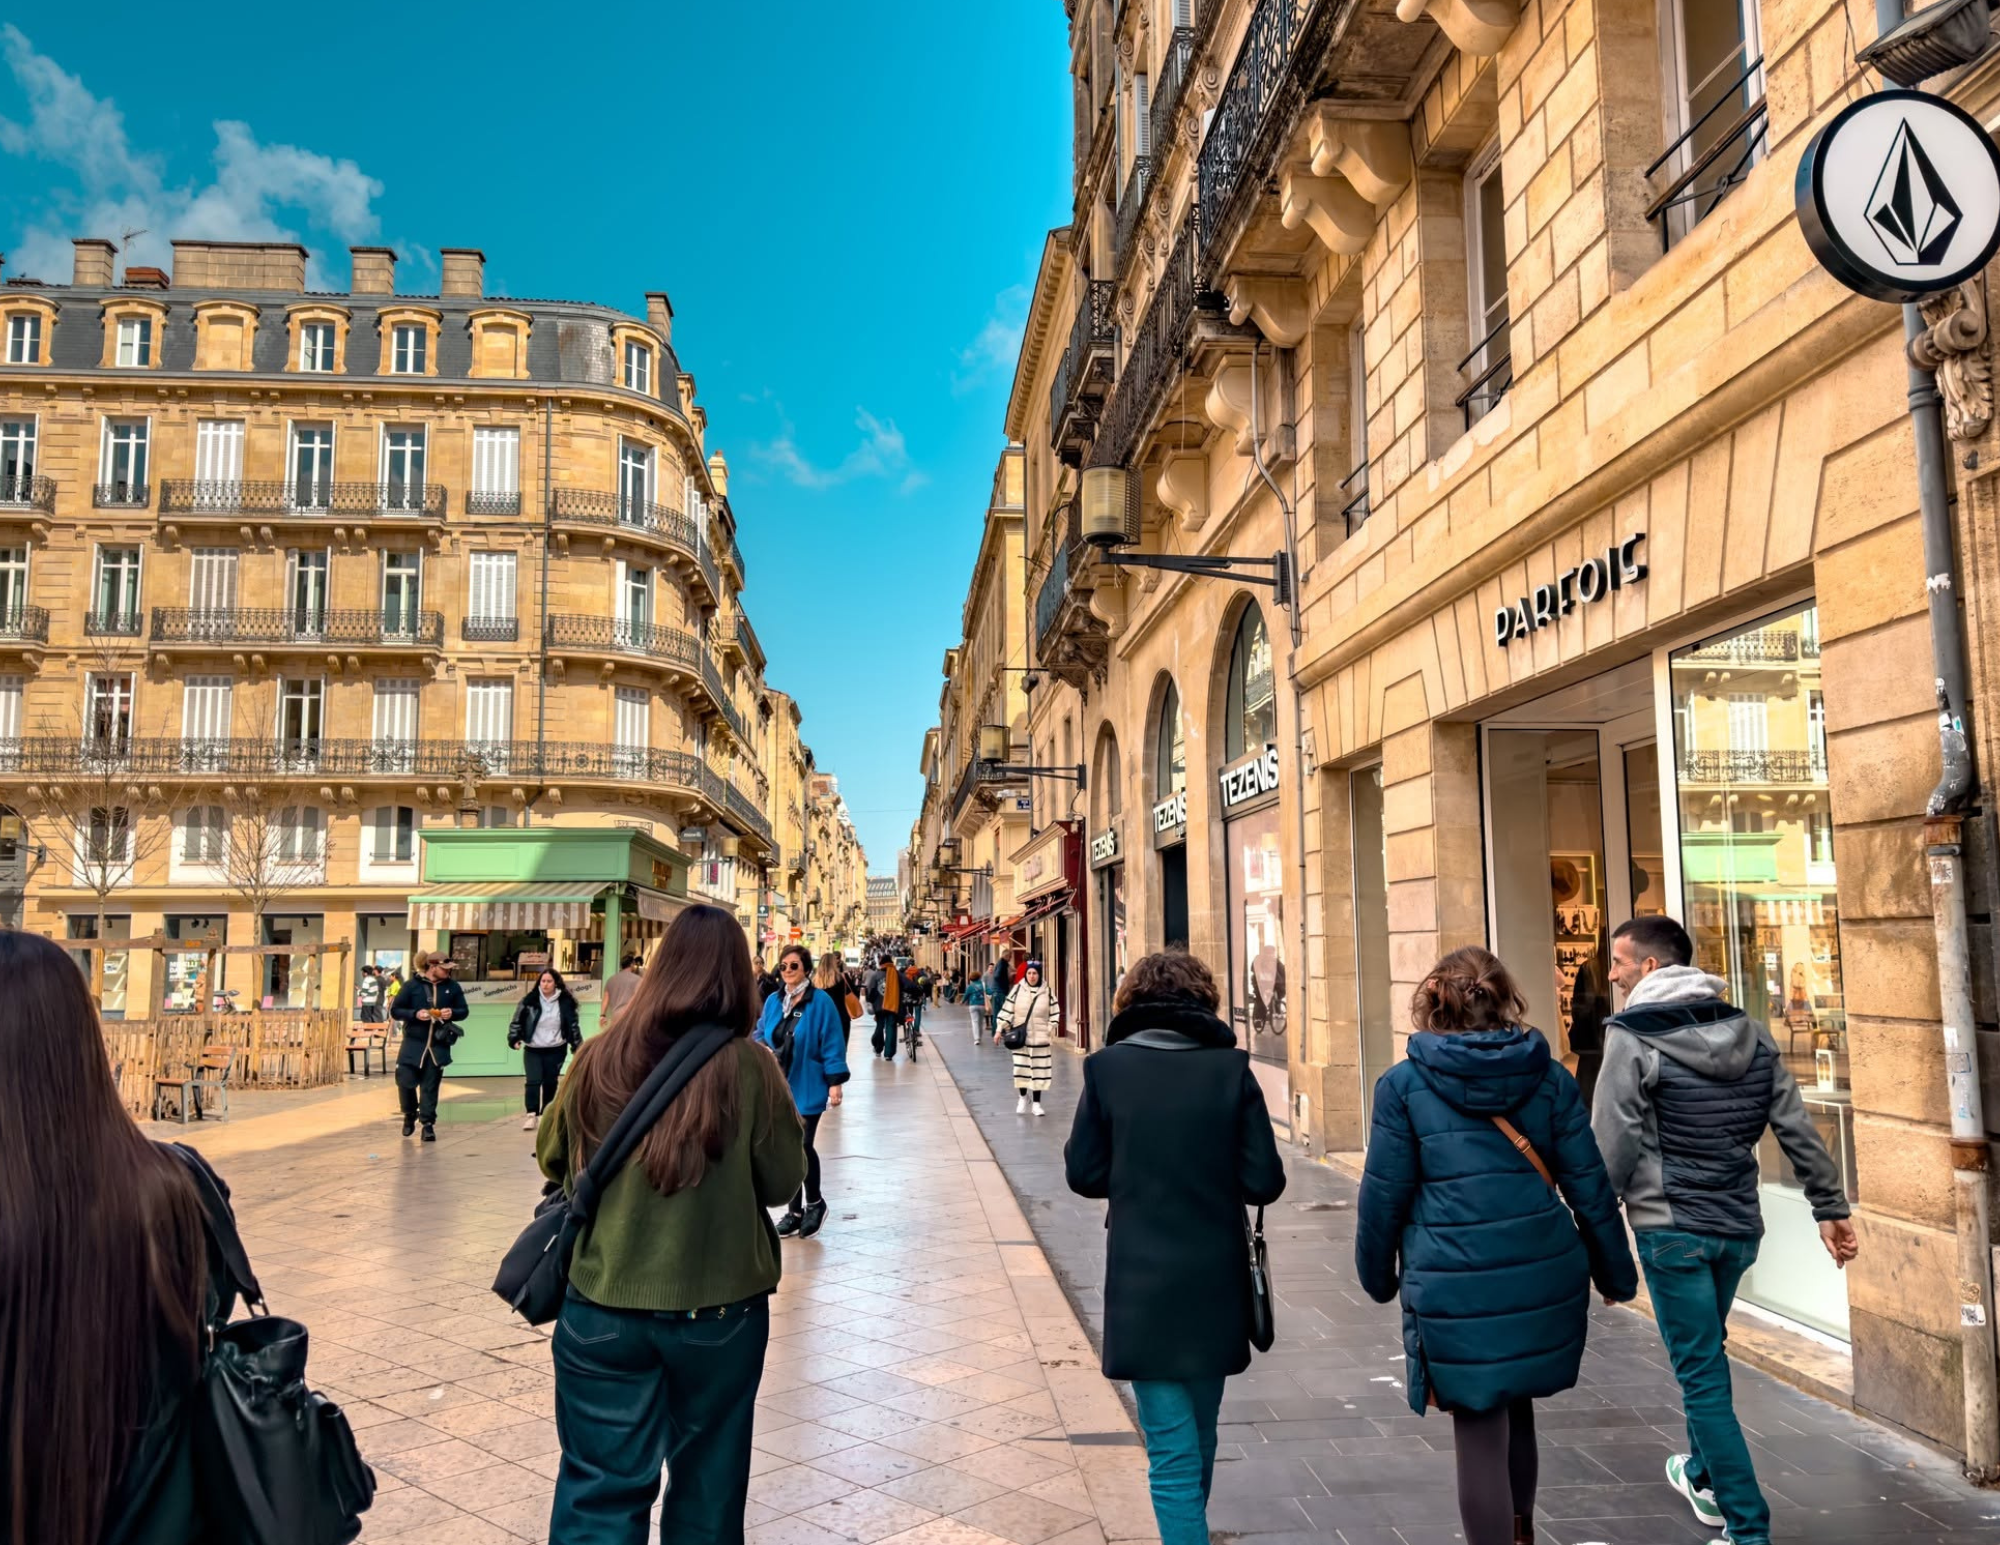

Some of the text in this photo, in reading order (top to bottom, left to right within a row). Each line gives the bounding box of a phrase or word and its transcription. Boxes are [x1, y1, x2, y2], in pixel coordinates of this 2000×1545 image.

[1495, 533, 1648, 647] PARFOIS
[1220, 744, 1279, 807] TEZENIS
[1153, 789, 1187, 833] TEZENIS
[1091, 828, 1115, 862] TEZENIS
[483, 984, 518, 998] Sandwichs
